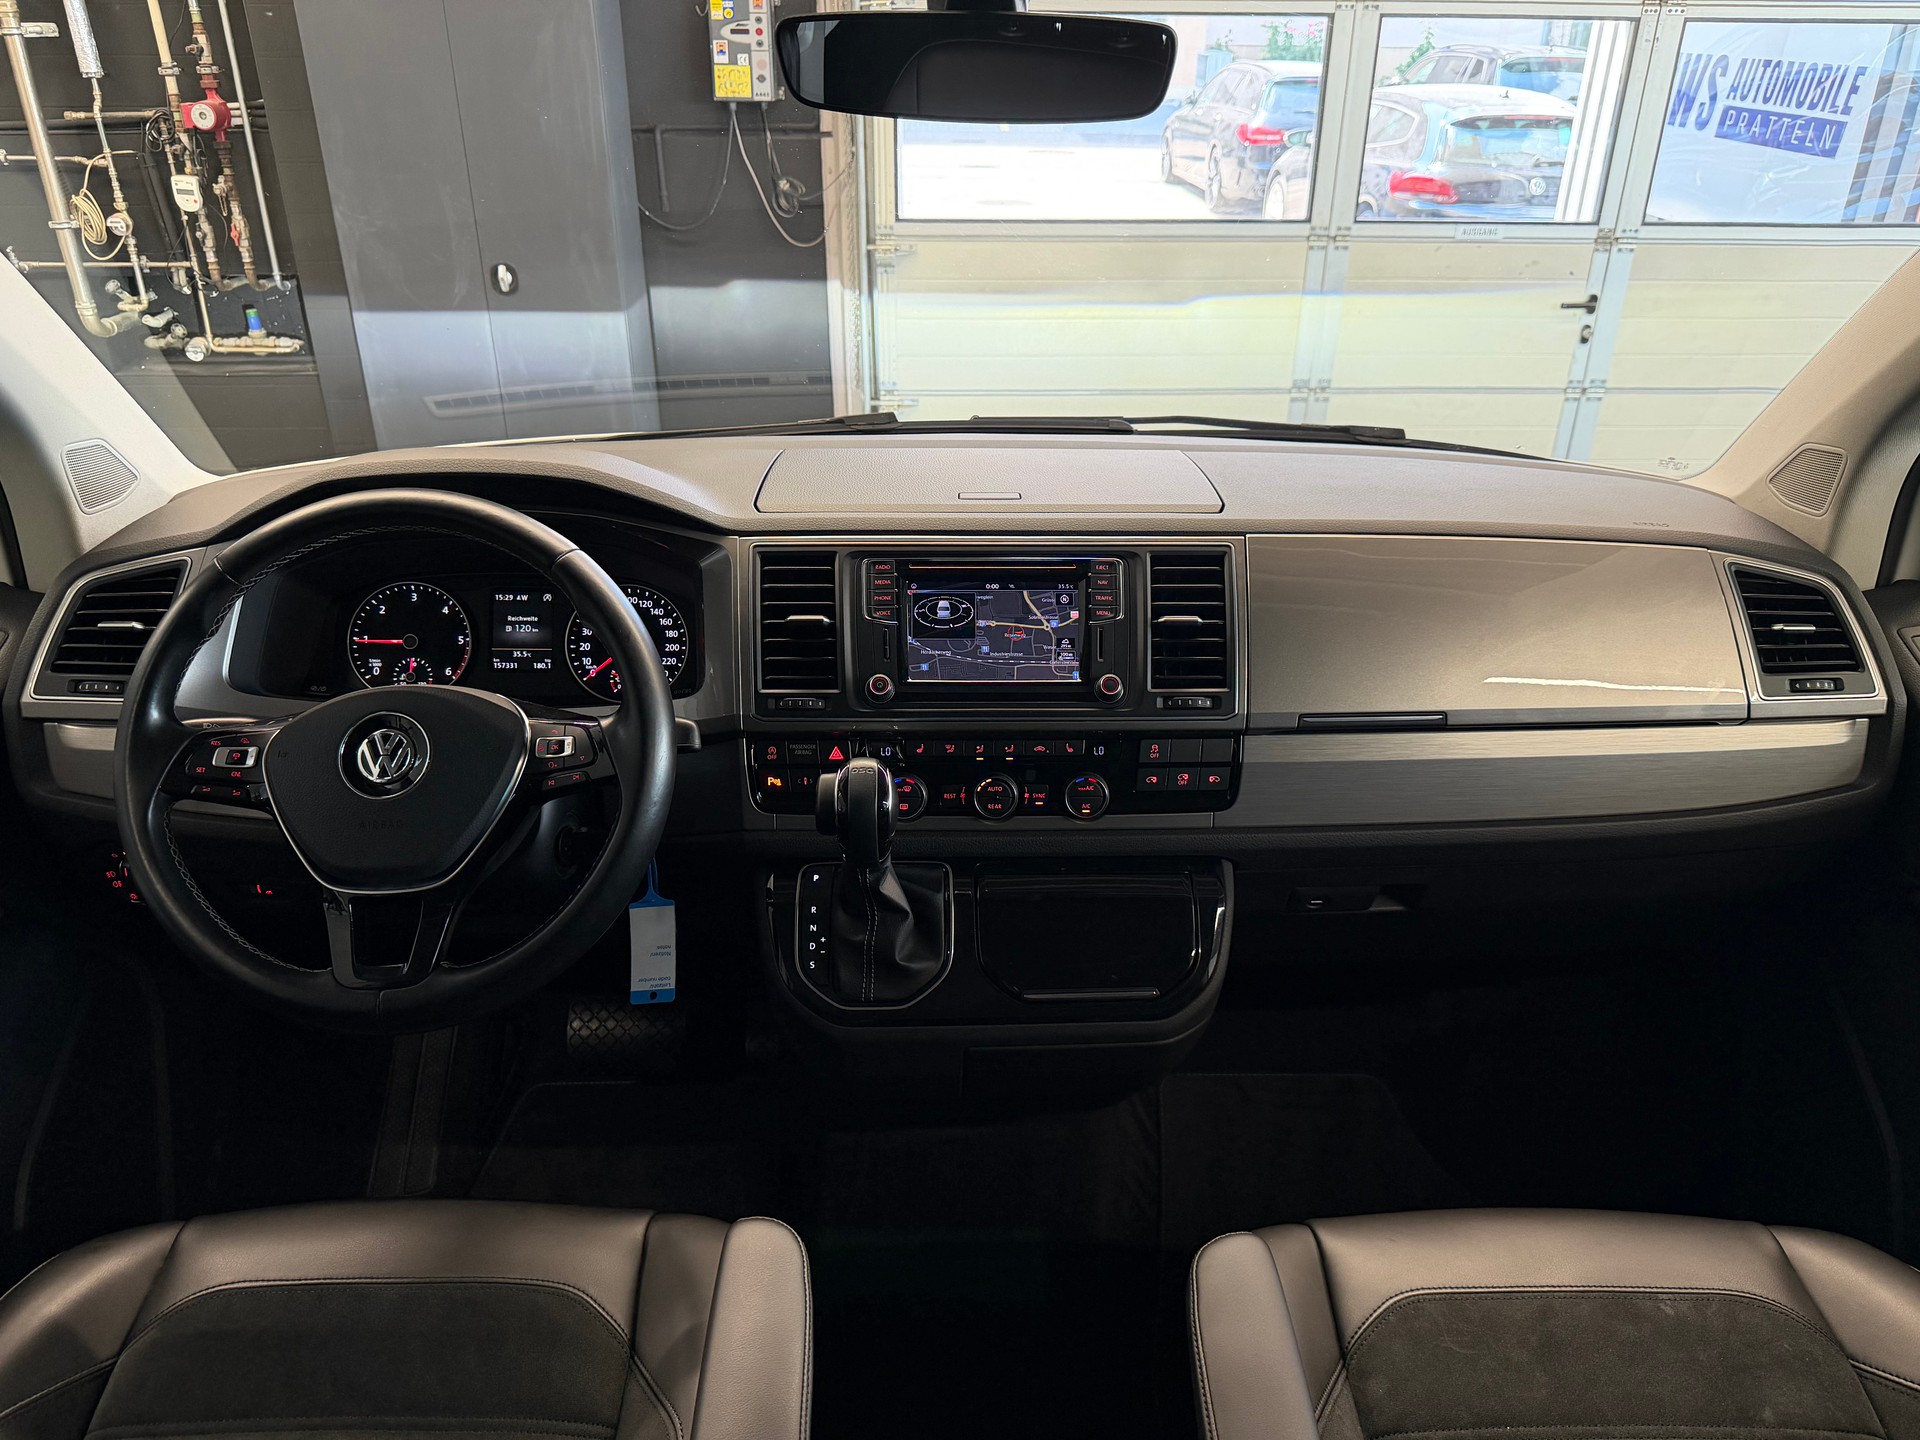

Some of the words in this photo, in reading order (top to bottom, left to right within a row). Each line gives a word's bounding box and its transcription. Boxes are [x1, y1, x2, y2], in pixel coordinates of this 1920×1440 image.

[1668, 53, 1729, 131] WS
[1726, 58, 1869, 116] AUTOMOBILE
[1724, 110, 1836, 150] PRATTELN
[411, 592, 418, 602] 3
[379, 606, 386, 614] 2
[442, 606, 449, 614] 4
[582, 628, 592, 636] 30
[458, 636, 464, 644] 5
[579, 643, 591, 651] 20
[582, 658, 592, 666] 10
[373, 667, 380, 676] 0
[445, 667, 452, 676] 6
[880, 746, 891, 756] LO
[1093, 746, 1105, 756] LO
[811, 906, 817, 914] R
[809, 961, 816, 969] S
